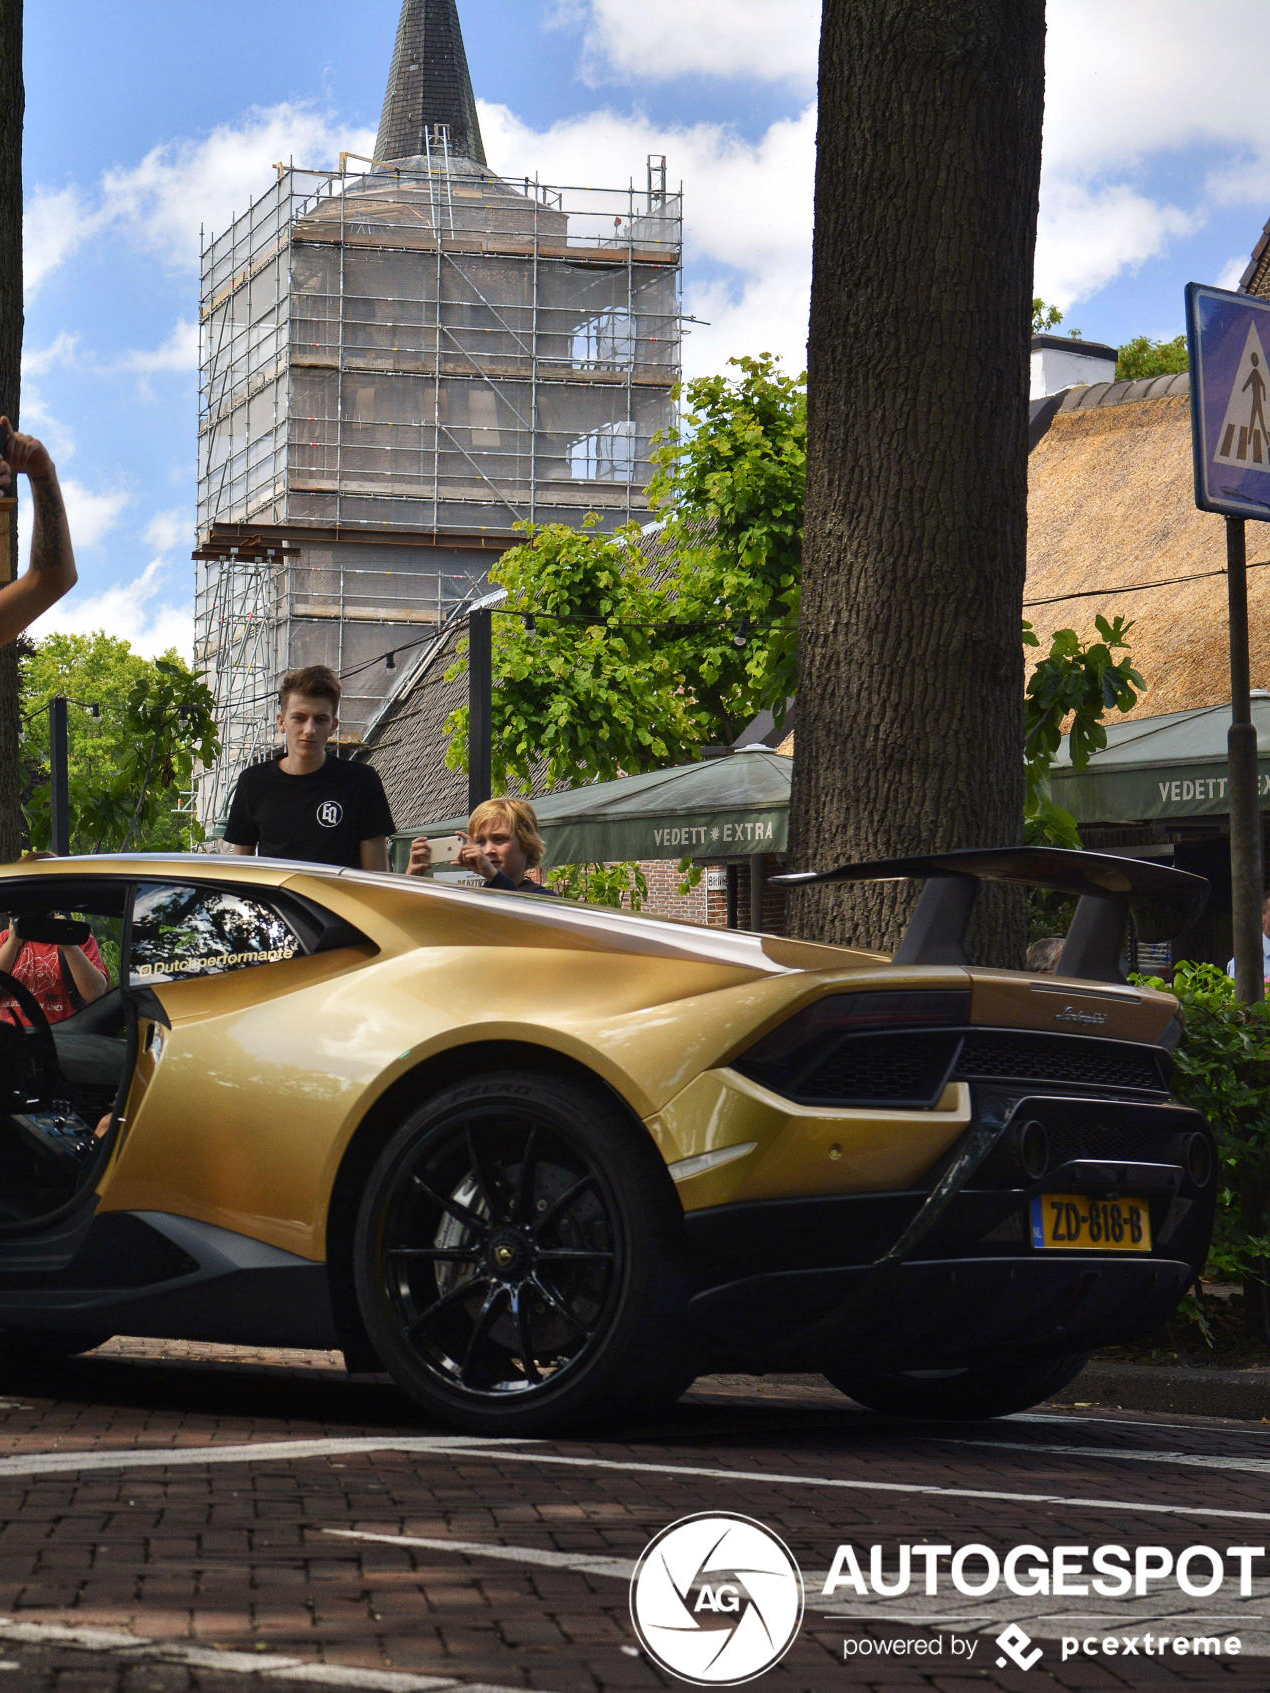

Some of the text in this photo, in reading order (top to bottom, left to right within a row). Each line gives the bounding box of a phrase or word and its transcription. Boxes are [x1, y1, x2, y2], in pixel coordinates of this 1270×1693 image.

[1158, 777, 1228, 802] VEDETT
[653, 821, 773, 847] VEDETT EXTRA
[1032, 1226, 1042, 1239] NL
[1050, 1201, 1143, 1243] ZD-818-B
